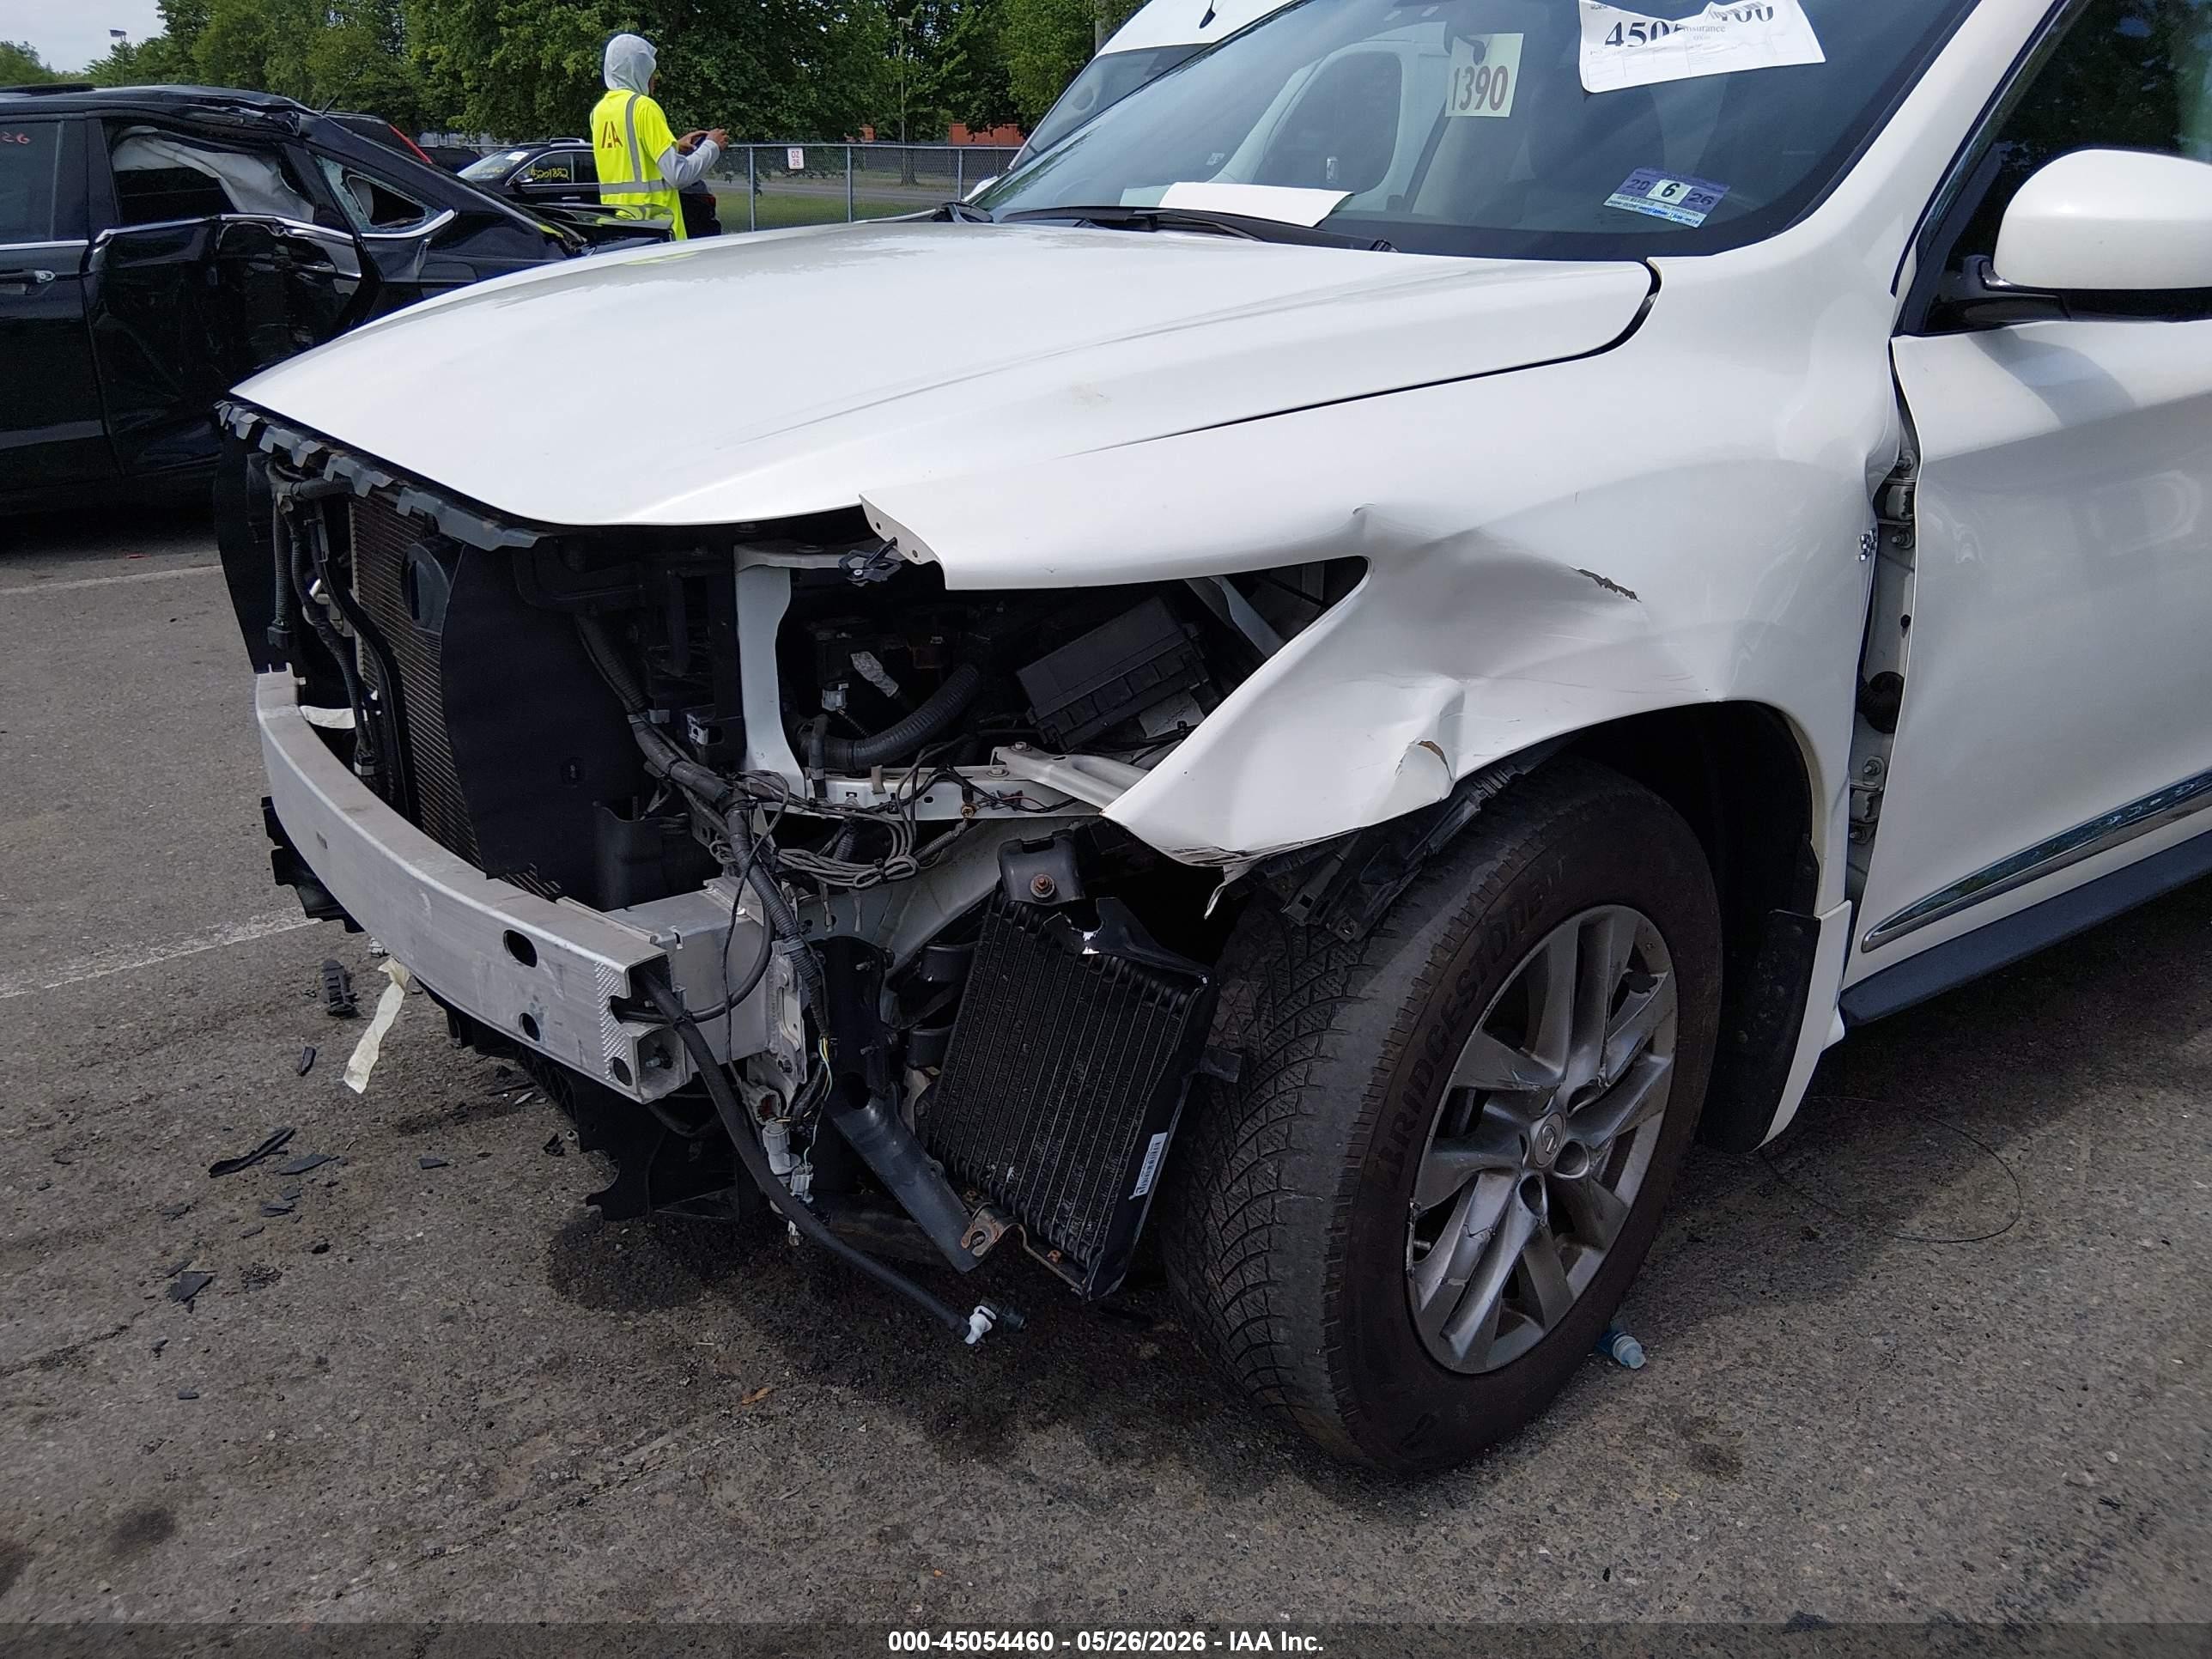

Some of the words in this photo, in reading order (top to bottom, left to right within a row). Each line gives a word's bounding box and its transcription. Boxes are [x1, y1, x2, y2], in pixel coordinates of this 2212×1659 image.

[1451, 65, 1509, 112] 1390
[1661, 182, 1680, 198] 6
[1688, 192, 1715, 205] 26
